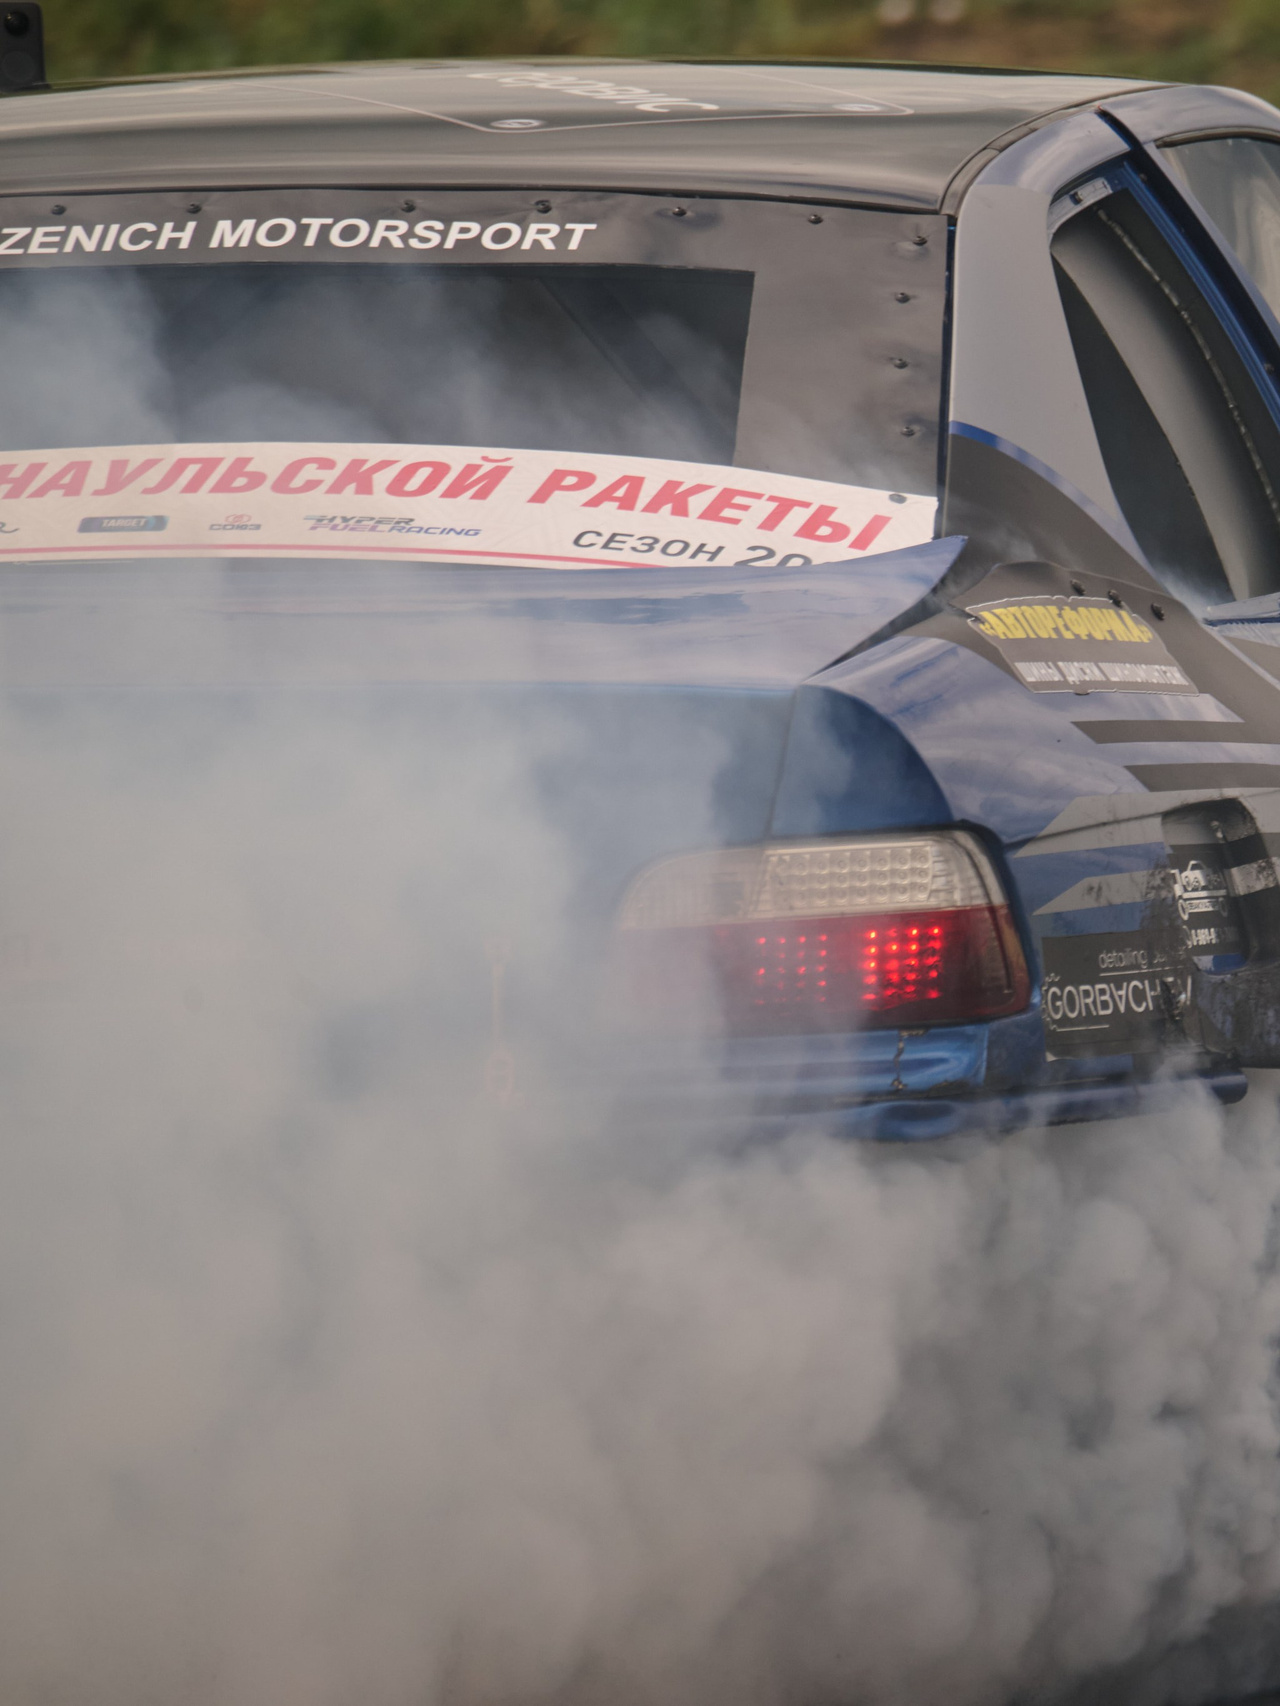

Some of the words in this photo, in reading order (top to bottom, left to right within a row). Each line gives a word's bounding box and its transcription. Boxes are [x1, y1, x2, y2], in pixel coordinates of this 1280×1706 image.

[0, 221, 197, 256] ZENICH
[208, 217, 597, 252] MOTORSPORT
[0, 455, 513, 501] НАУЛЬСКОЙ
[527, 468, 893, 552] РАКЕТЫ
[101, 517, 148, 528] TARGET
[310, 515, 422, 527] HYPER
[571, 529, 726, 562] СЕЗОН
